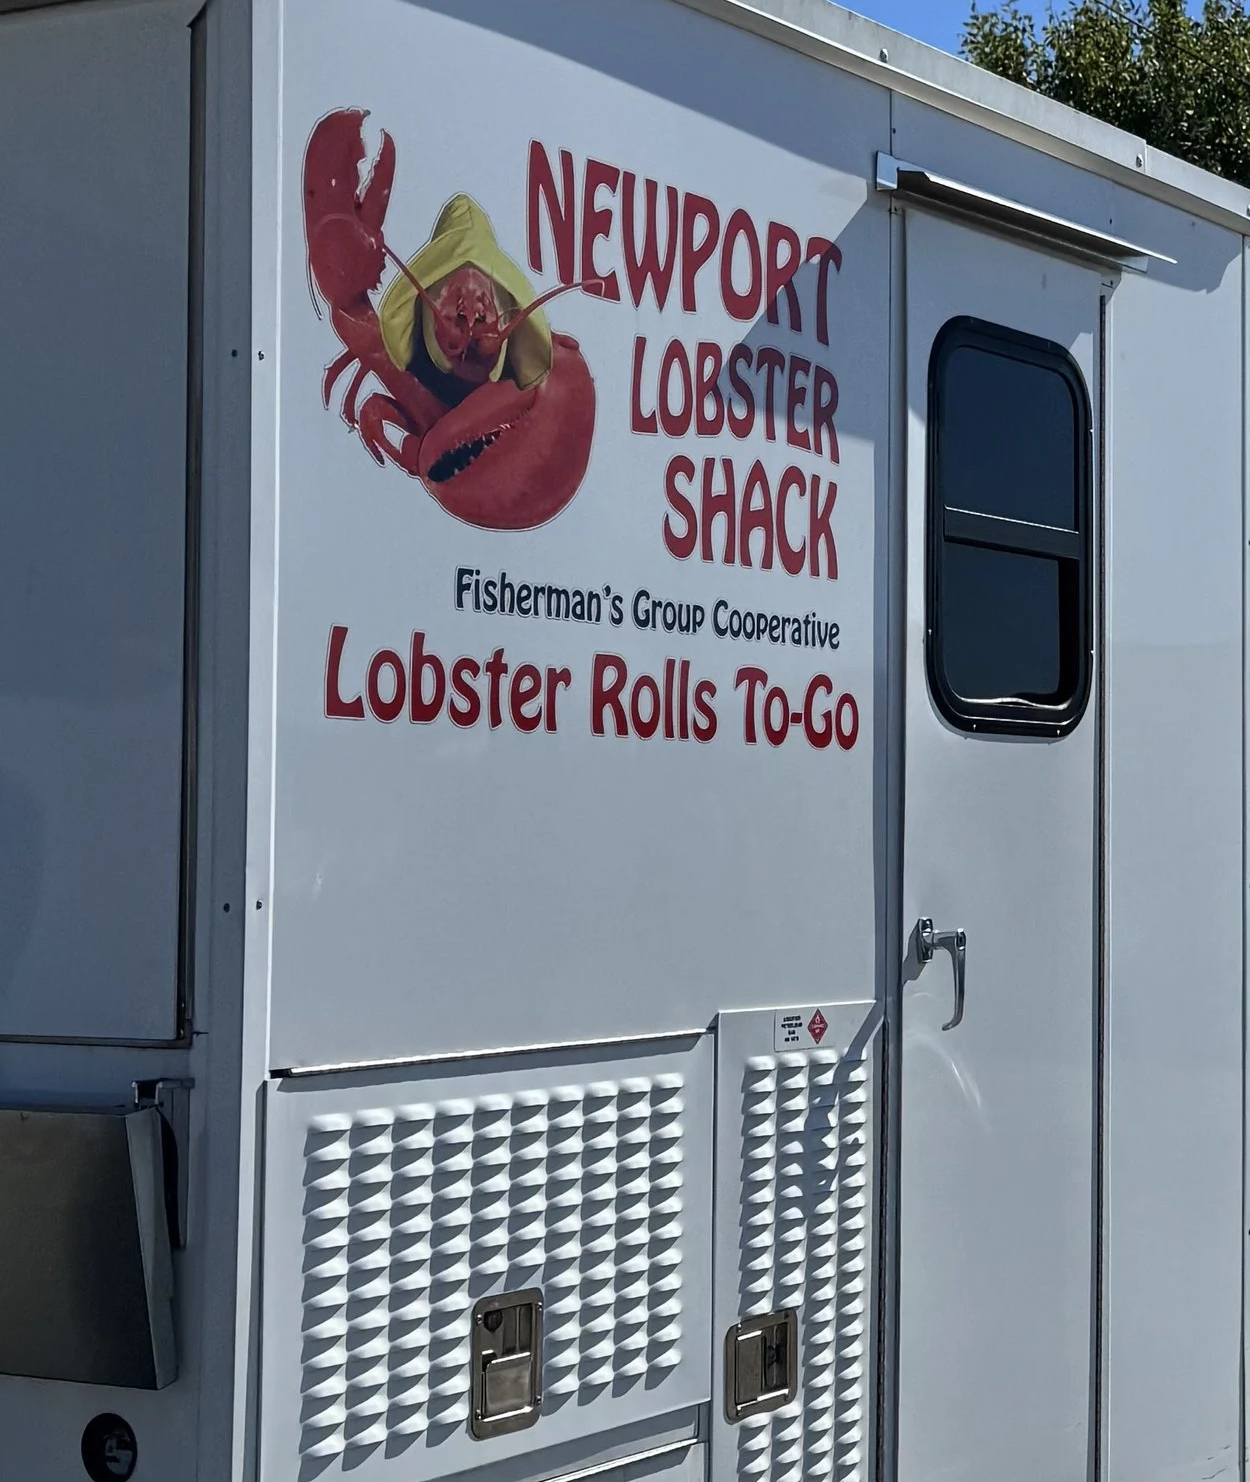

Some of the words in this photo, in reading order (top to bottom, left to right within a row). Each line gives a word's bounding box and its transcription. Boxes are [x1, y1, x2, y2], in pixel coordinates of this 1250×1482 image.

[528, 138, 842, 346] NEWPORT
[631, 335, 839, 463] LOBSTER
[663, 455, 838, 580] SHACK
[455, 566, 623, 627] Fisherman's
[632, 588, 705, 634] Group
[712, 599, 840, 650] Cooperative
[324, 624, 572, 734] Lobster
[591, 652, 718, 743] Rolls
[732, 665, 859, 751] To-Go
